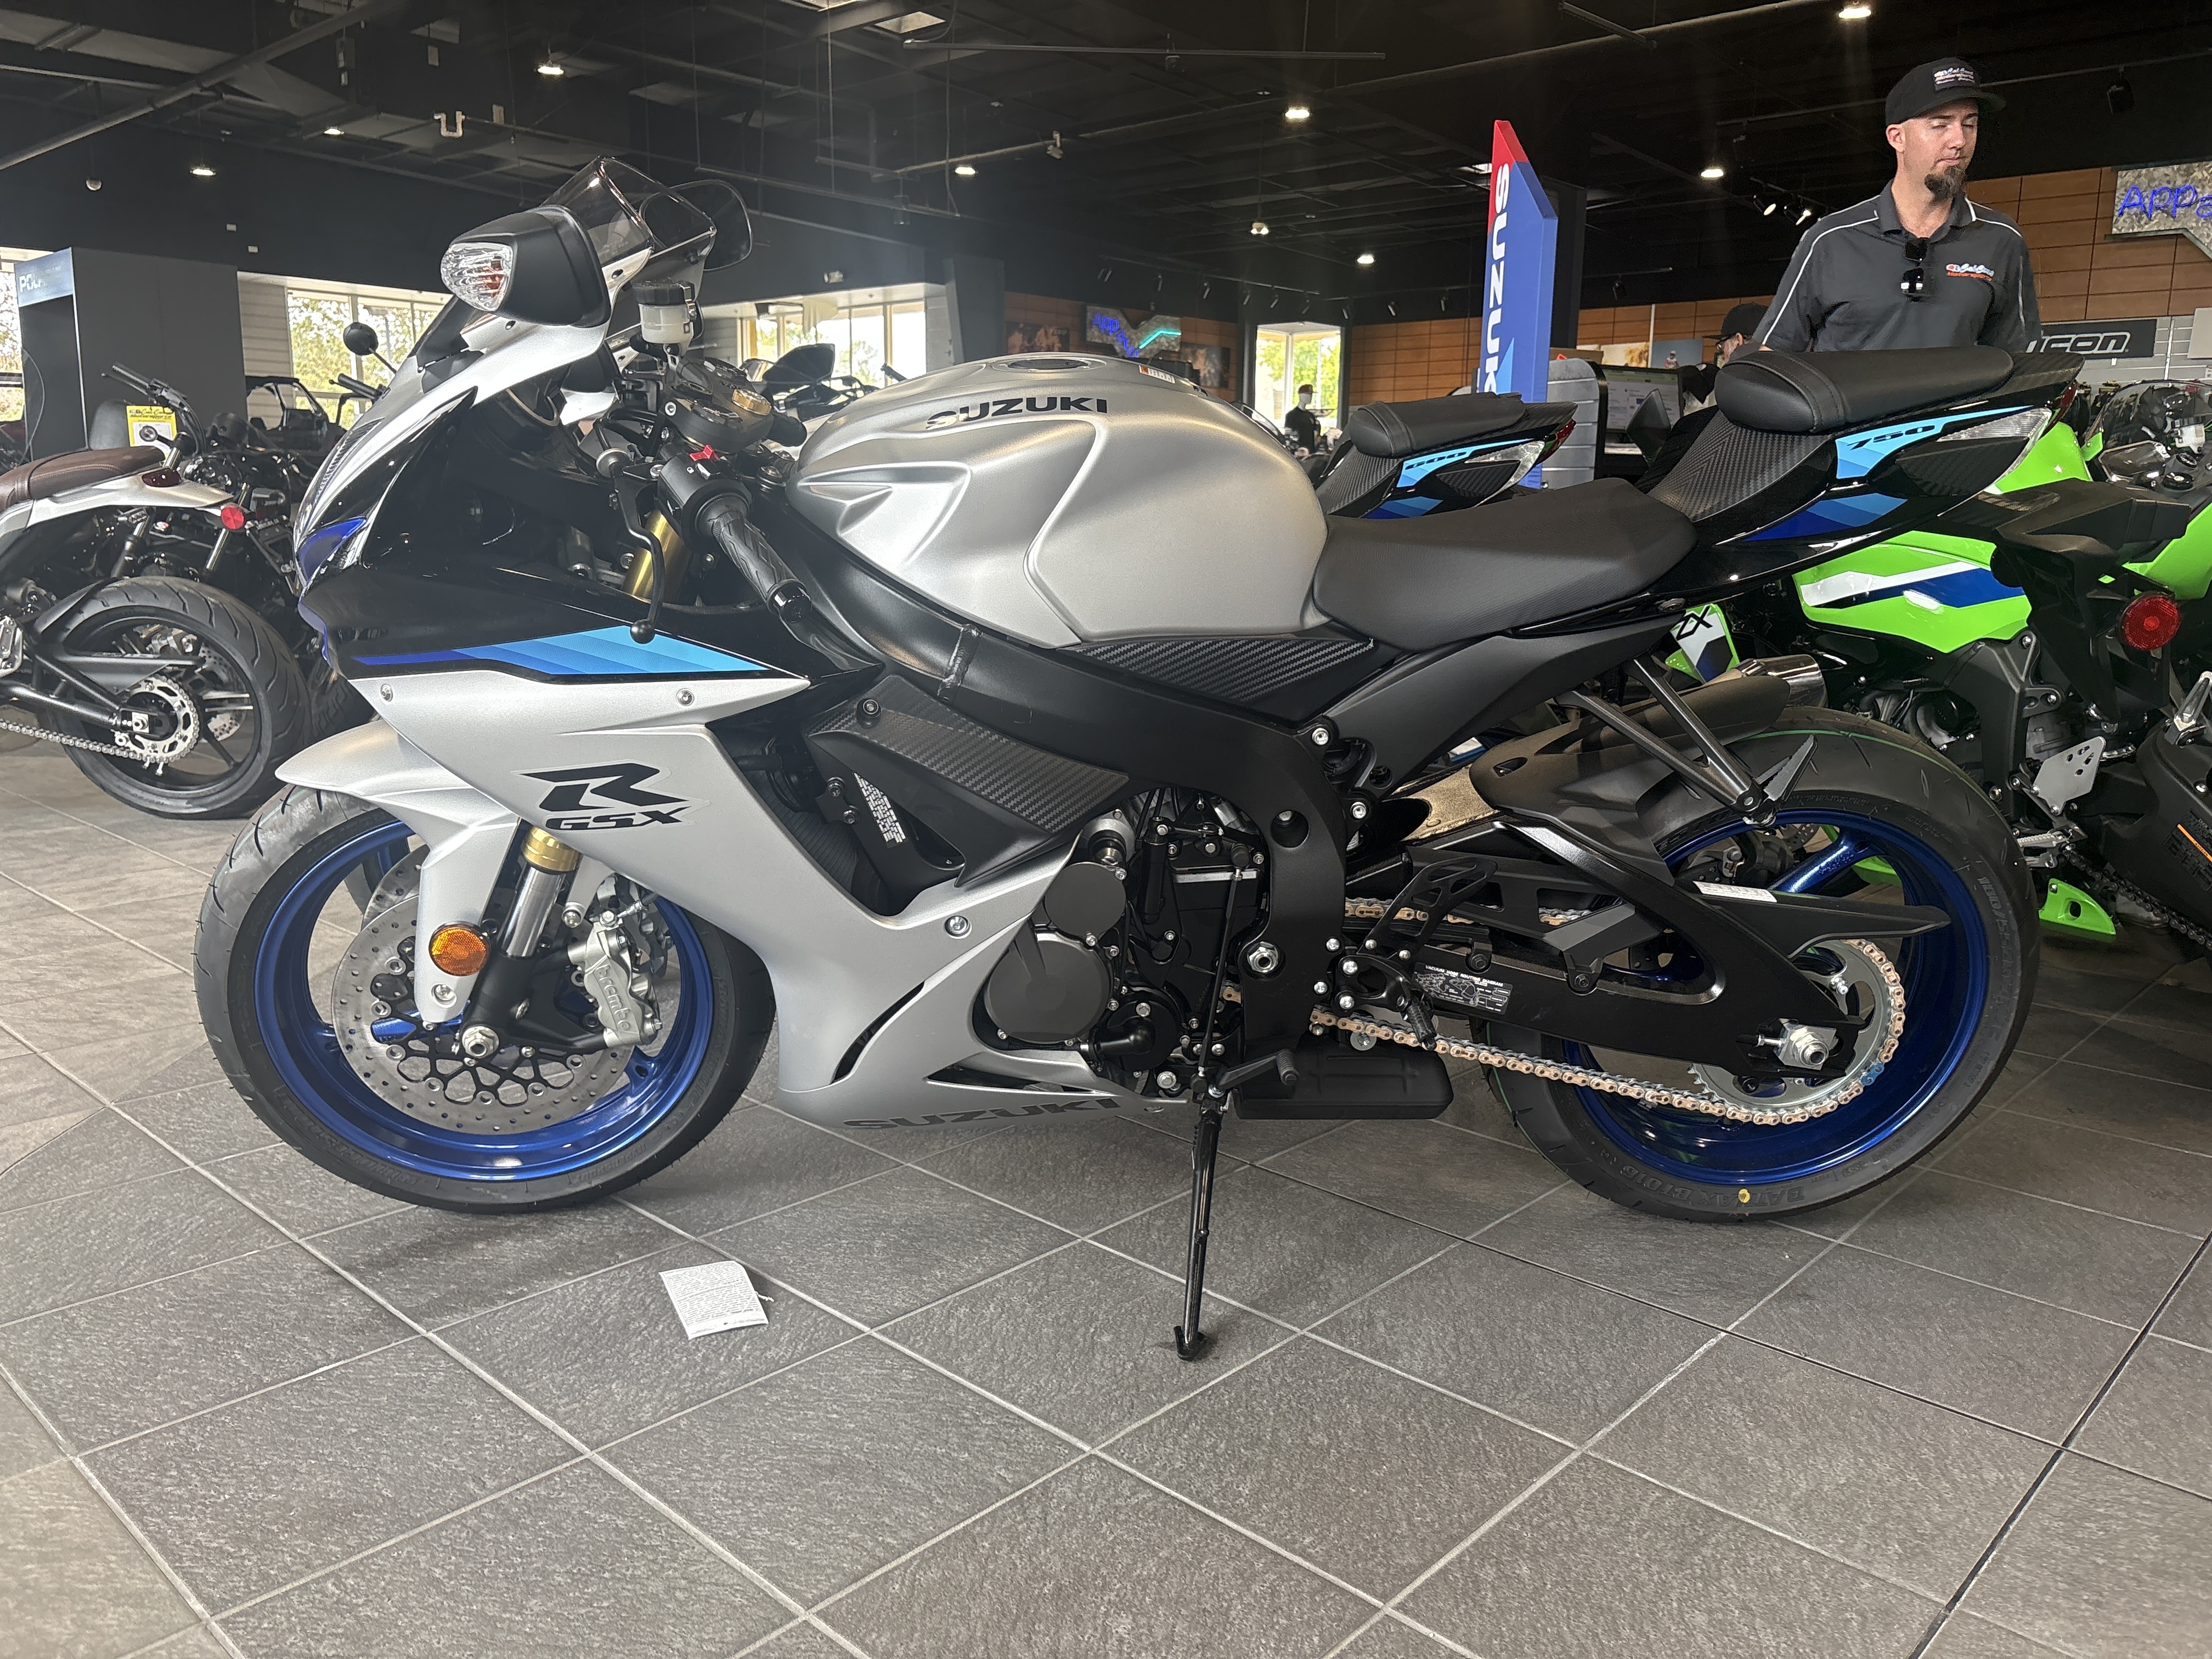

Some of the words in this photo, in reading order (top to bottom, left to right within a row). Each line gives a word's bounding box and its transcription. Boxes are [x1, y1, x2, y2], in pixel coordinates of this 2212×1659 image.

[1484, 163, 1510, 393] SUZUK
[926, 396, 1108, 431] SUZUKI
[1847, 424, 1936, 451] 750
[518, 762, 690, 812] R
[545, 805, 693, 831] GSX
[1425, 964, 1446, 973] VACUUM
[1460, 973, 1481, 982] ROUTING
[1482, 978, 1504, 987] DIAGRAM
[595, 963, 630, 1031] brembo
[843, 1097, 1122, 1130] SUZUKI
